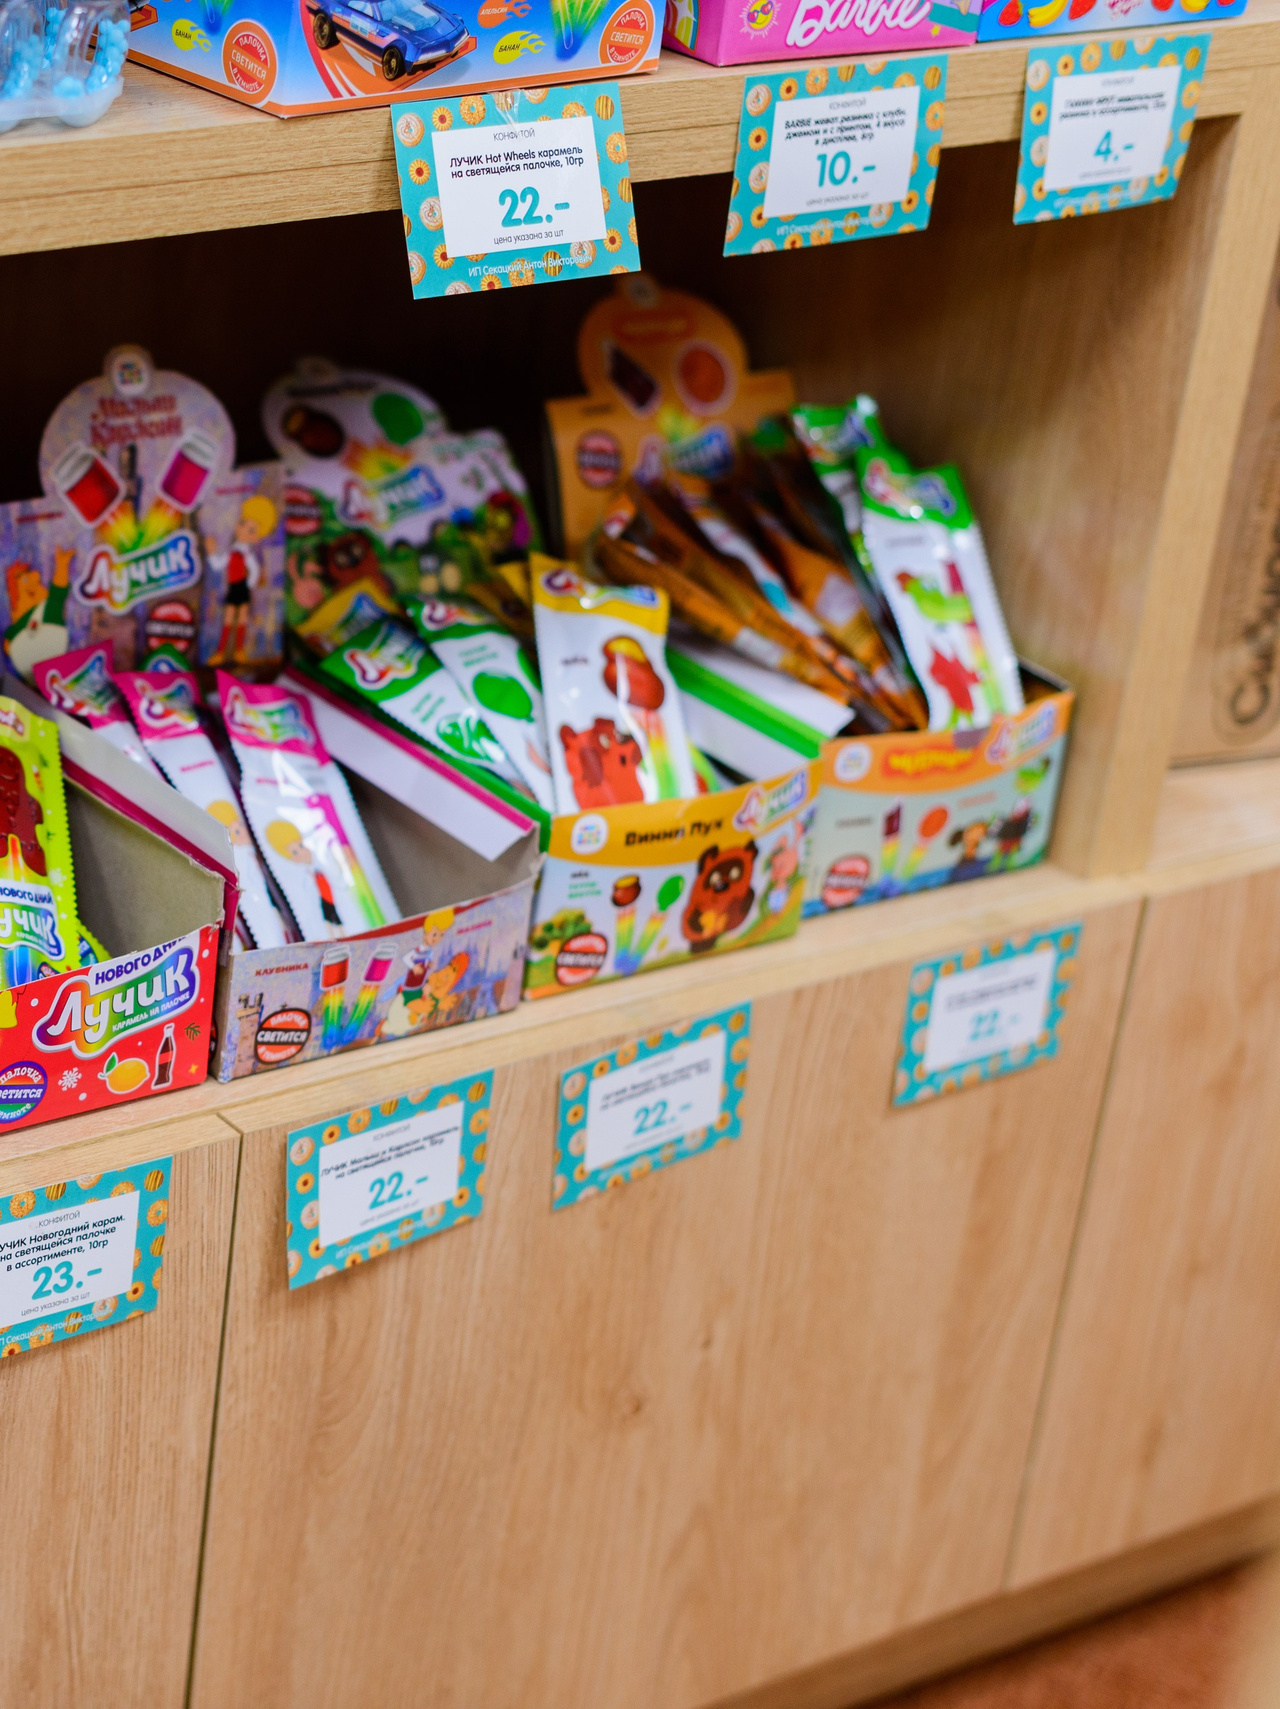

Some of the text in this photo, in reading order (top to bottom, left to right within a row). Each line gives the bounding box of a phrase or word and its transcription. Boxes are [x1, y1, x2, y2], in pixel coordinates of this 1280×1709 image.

[480, 7, 508, 15] АПЕЛЬСИН
[620, 11, 645, 29] ПАЛОЧКА
[175, 29, 191, 39] БАНАН
[610, 31, 645, 45] СВЕТИТСЯ
[239, 36, 266, 61] ПАЛОЧКА
[499, 44, 521, 52] БАНАН
[612, 50, 637, 62] ТЕМНОТЕ
[231, 50, 267, 80] СВЕТИТСЯ
[235, 73, 259, 91] ТЕМНОТЕ
[493, 129, 535, 141] КОНФИТОЙ
[450, 146, 583, 168] ЛУЧИК Hot Wheels карамель
[451, 156, 584, 179] на светящейся палочке, 10гр
[816, 151, 876, 188] 10.-
[498, 187, 570, 228] 22.-
[493, 229, 564, 245] цена указана за шт
[469, 254, 592, 277] ИП Секацкий Антон Викторович
[83, 540, 188, 603] Лучик
[624, 819, 724, 847] Винни Пух
[95, 936, 186, 985] НОВОГОДН
[255, 962, 309, 977] КЛУБНИКА
[46, 953, 189, 1044] Лучик
[112, 991, 191, 1033] КАРАМЕЛЬ НА ПАЛОЧКЕ
[256, 1031, 307, 1044] СВЕТИТСЯ
[321, 1163, 348, 1177] ЛУЧИК
[369, 1171, 429, 1210] 22.-
[29, 1223, 90, 1245] Новогодний
[92, 1215, 126, 1232] карам.
[38, 1210, 81, 1228] КОНФИТОЙ
[0, 1225, 116, 1262] на светящейся палочке
[15, 1247, 86, 1270] ассортименте,
[89, 1239, 109, 1251] 10гр
[32, 1261, 102, 1301] 23.-
[21, 1292, 91, 1317] цена указана за шт
